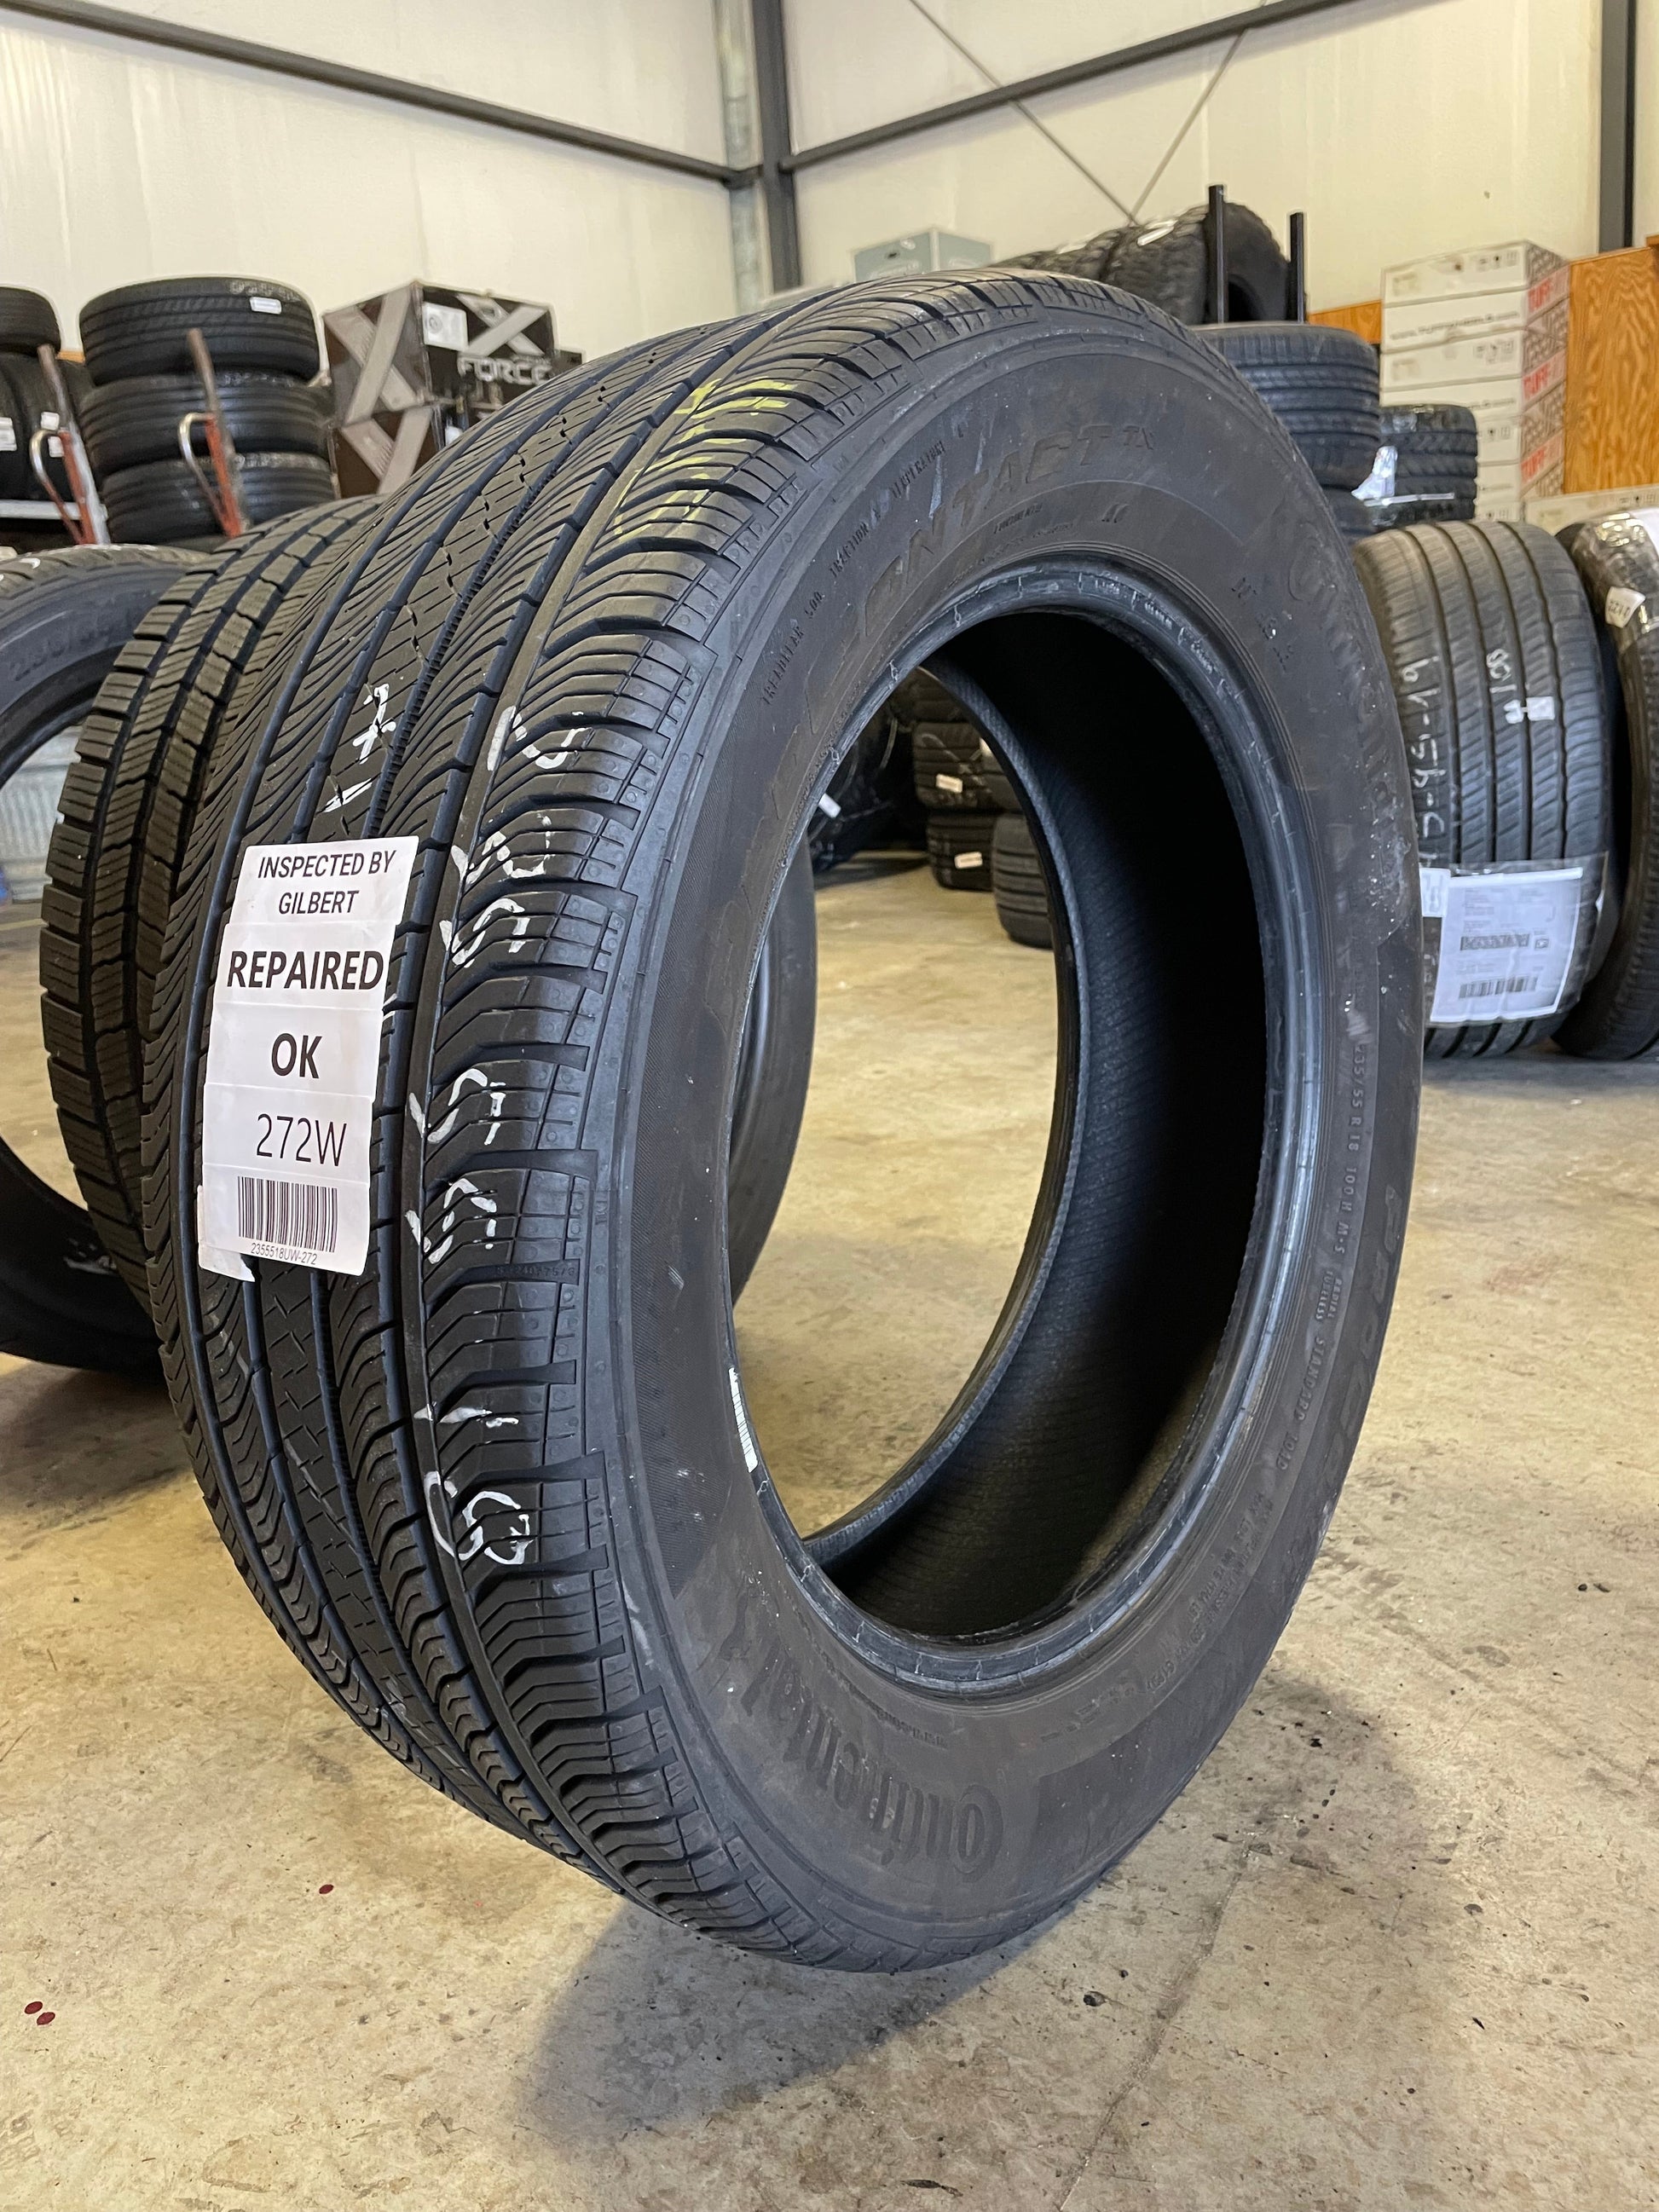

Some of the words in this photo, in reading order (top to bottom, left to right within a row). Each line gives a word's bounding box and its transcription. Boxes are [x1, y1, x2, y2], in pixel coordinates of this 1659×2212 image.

[258, 852, 363, 879] INSPECTED
[368, 850, 396, 875] BY
[278, 890, 358, 915] GILBERT
[226, 950, 384, 990] REPAIRED
[271, 1033, 322, 1079] OK
[256, 1113, 347, 1167] 272W
[251, 1243, 318, 1266] 2355518UW-272
[1293, 1336, 1325, 1422] STANDARD
